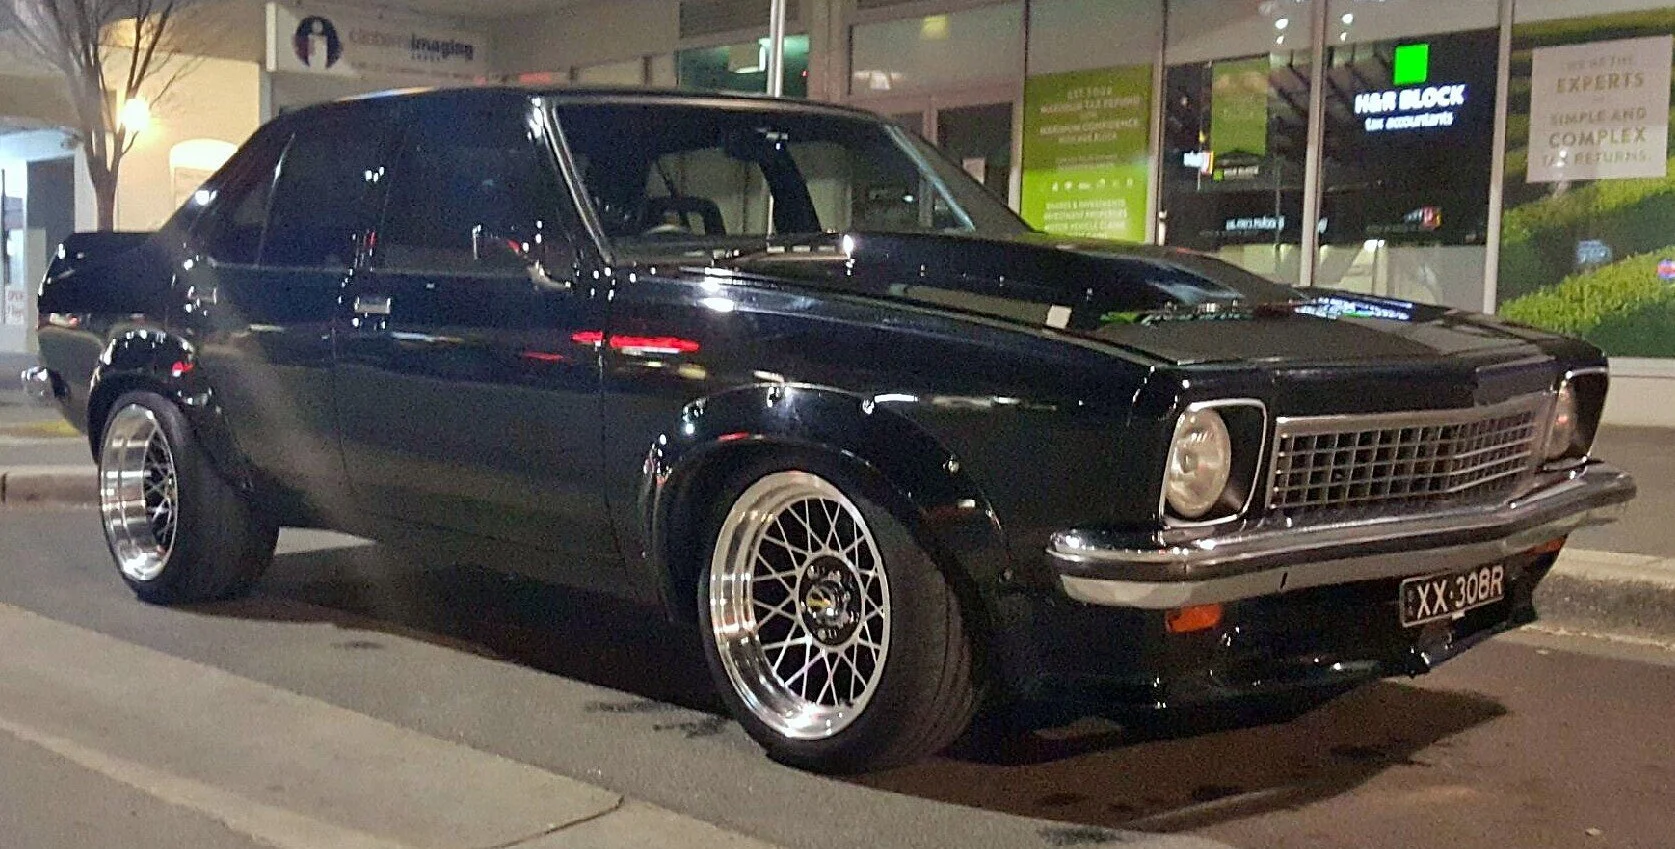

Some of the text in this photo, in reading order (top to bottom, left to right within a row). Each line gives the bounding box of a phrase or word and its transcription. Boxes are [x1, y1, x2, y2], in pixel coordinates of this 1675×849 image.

[1556, 72, 1645, 94] EXPERTS
[1354, 84, 1466, 114] H&R BLOCK
[1385, 111, 1454, 130] accountants
[1549, 105, 1648, 126] SIMPLE AND
[1548, 125, 1647, 149] COMPLEX
